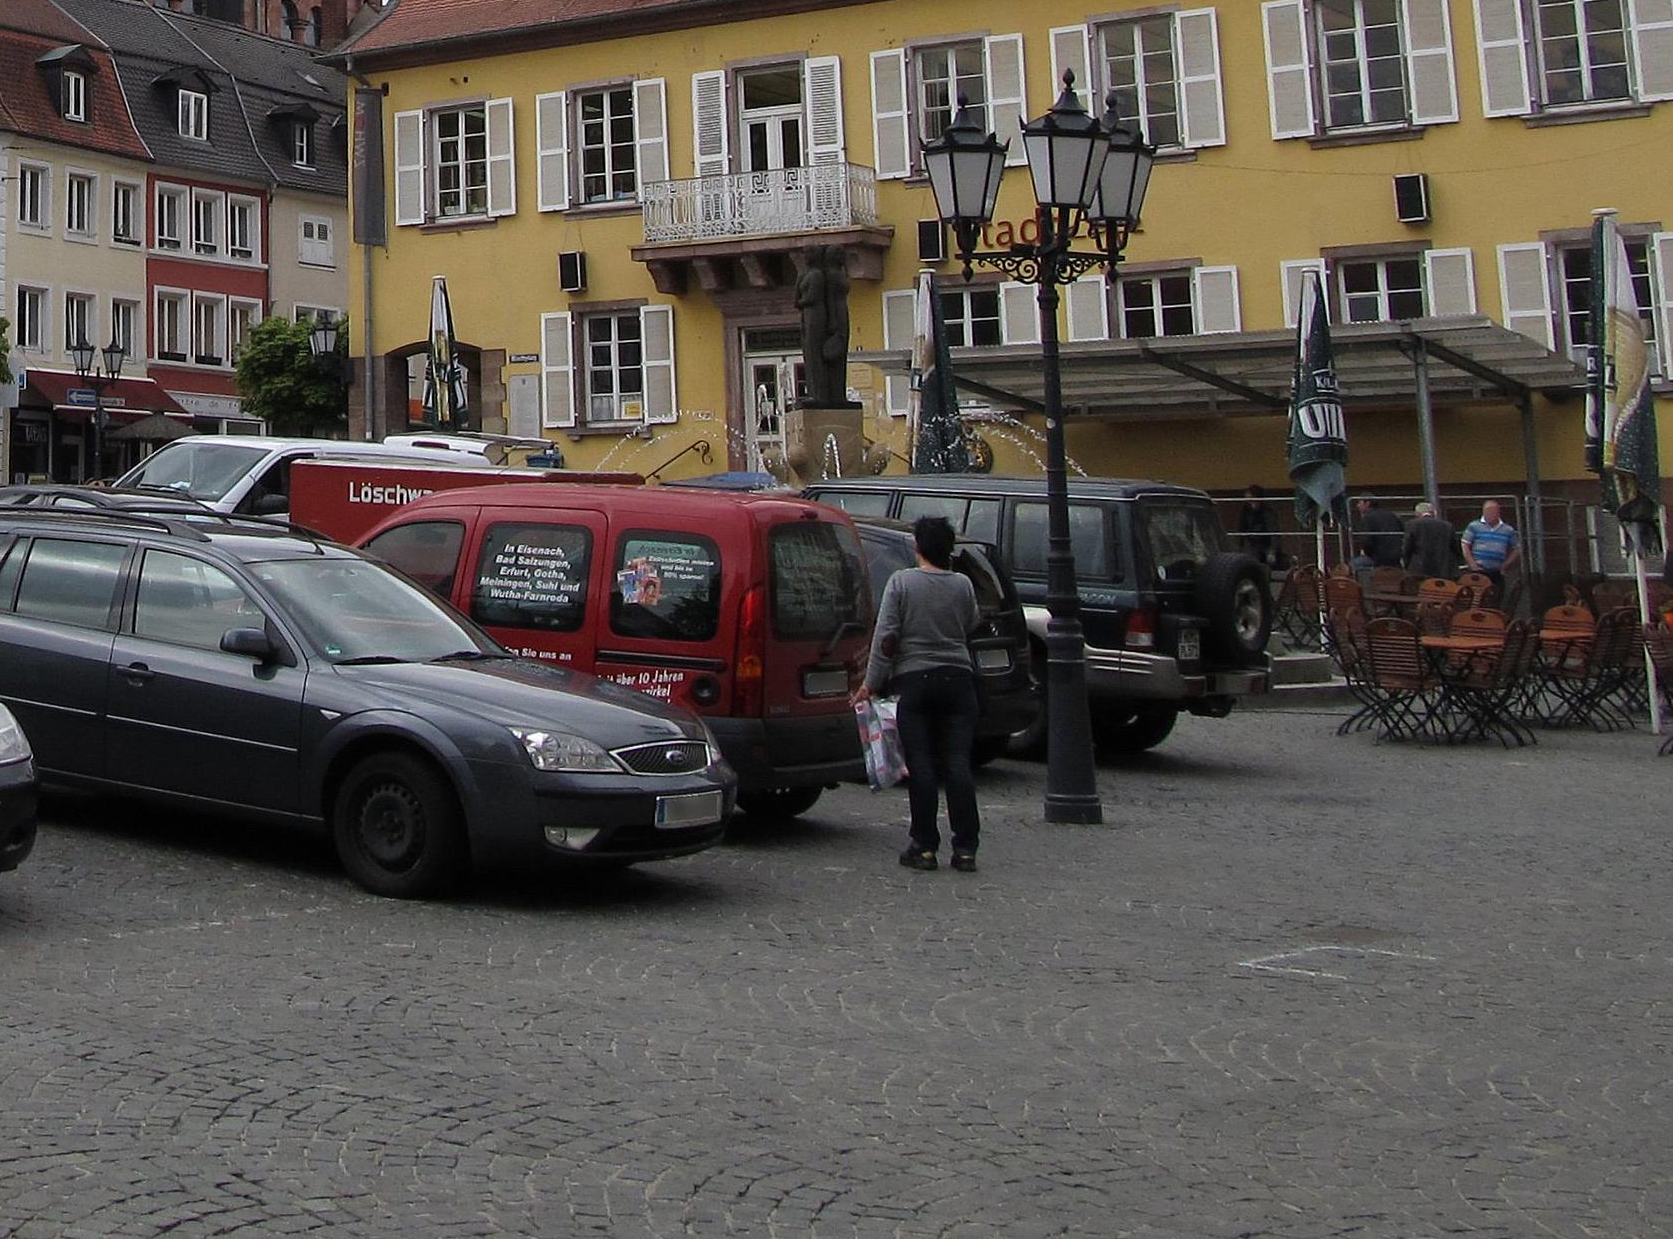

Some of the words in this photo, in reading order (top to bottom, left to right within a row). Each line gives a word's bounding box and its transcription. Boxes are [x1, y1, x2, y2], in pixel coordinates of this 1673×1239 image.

[504, 543, 515, 553] In
[517, 544, 565, 558] Eisenach,
[495, 555, 516, 564] Bad
[517, 556, 571, 569] Salzungen,
[499, 566, 531, 579] Erfurt,
[534, 569, 567, 581] Gotha,
[479, 576, 533, 590] Meiningen,
[535, 580, 558, 591] Suhl
[560, 583, 580, 593] und
[490, 588, 569, 603] Wutha-Farnroda
[539, 650, 558, 660] uns
[559, 652, 573, 661] an
[638, 672, 651, 685] 10
[651, 669, 684, 683] Jahren
